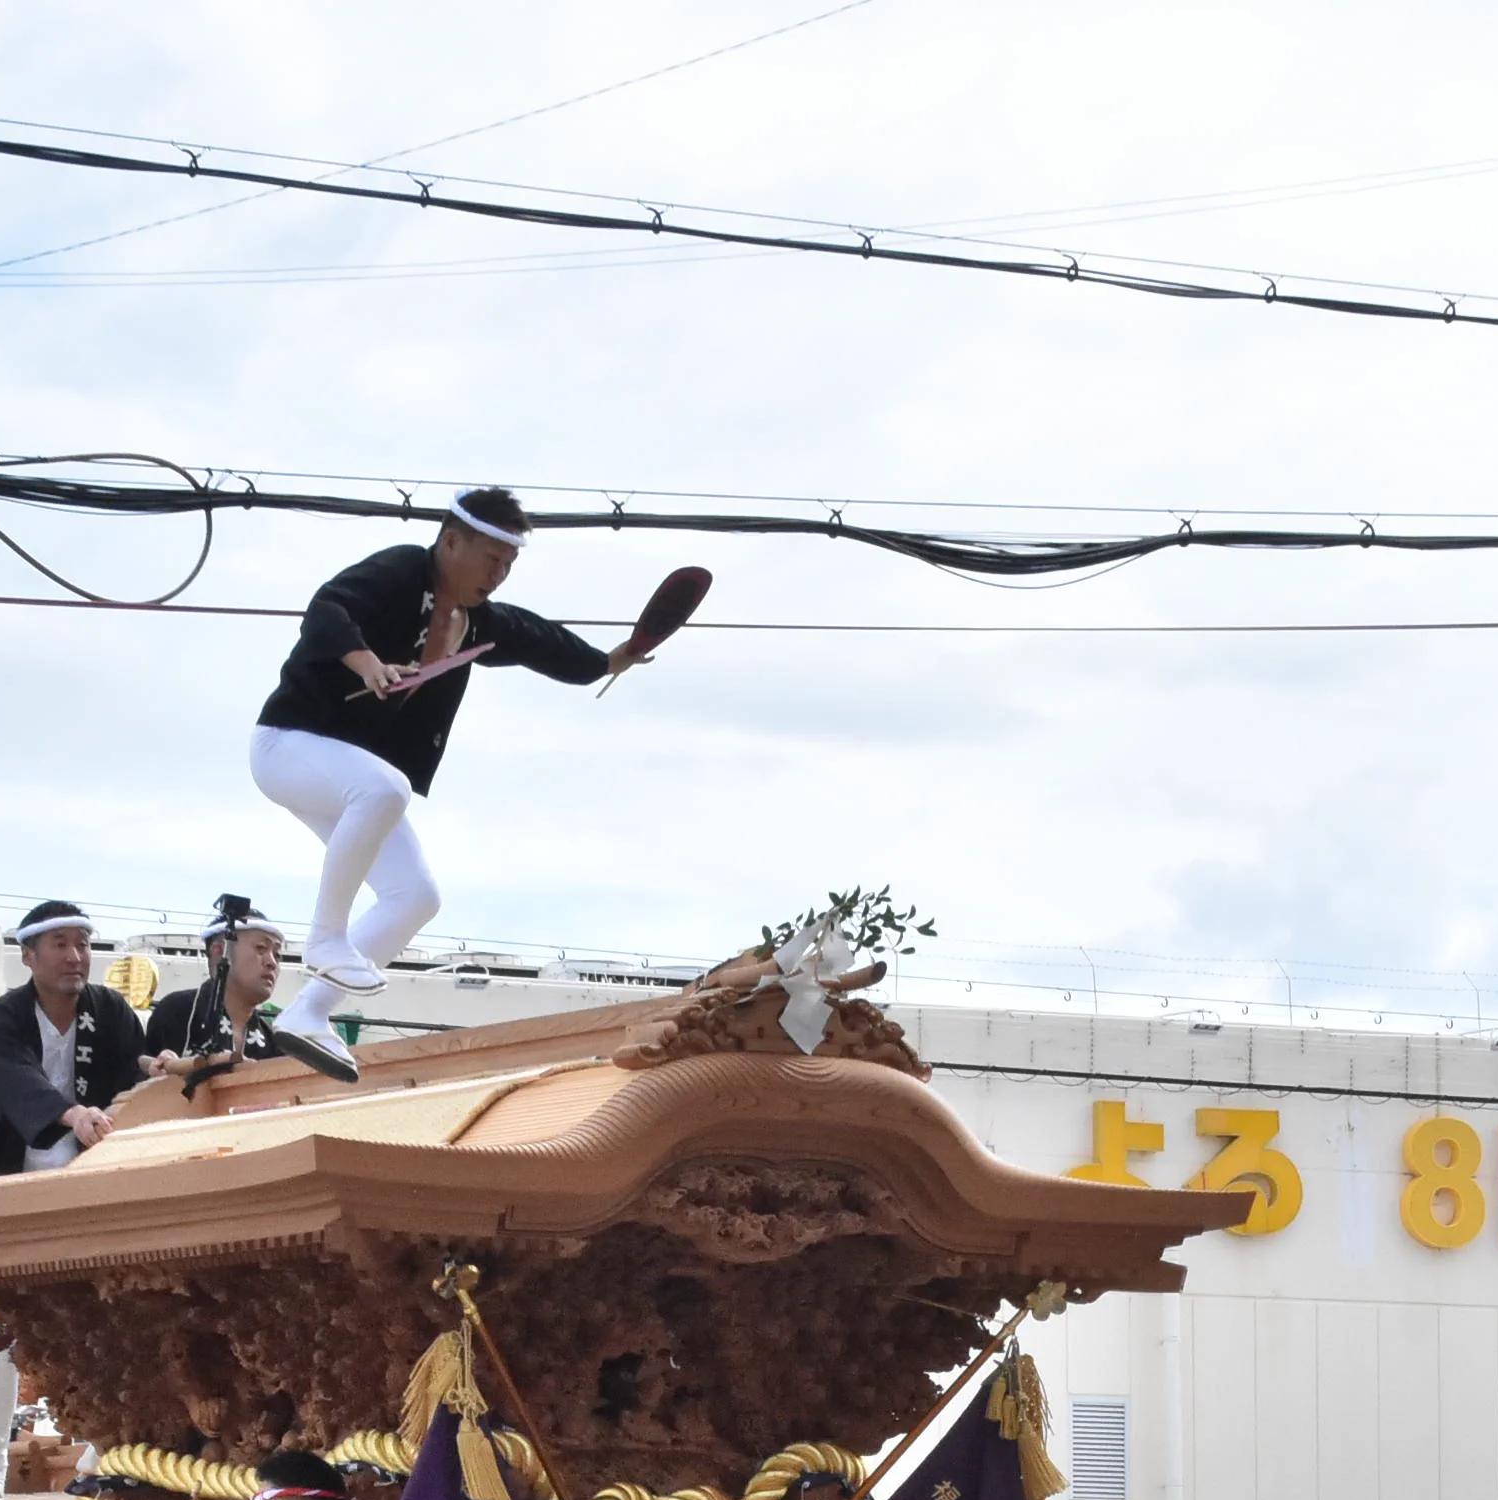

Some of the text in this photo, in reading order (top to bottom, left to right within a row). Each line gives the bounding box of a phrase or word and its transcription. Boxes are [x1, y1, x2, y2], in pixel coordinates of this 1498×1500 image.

[74, 1010, 98, 1098] 大工方
[1061, 1100, 1303, 1236] よる
